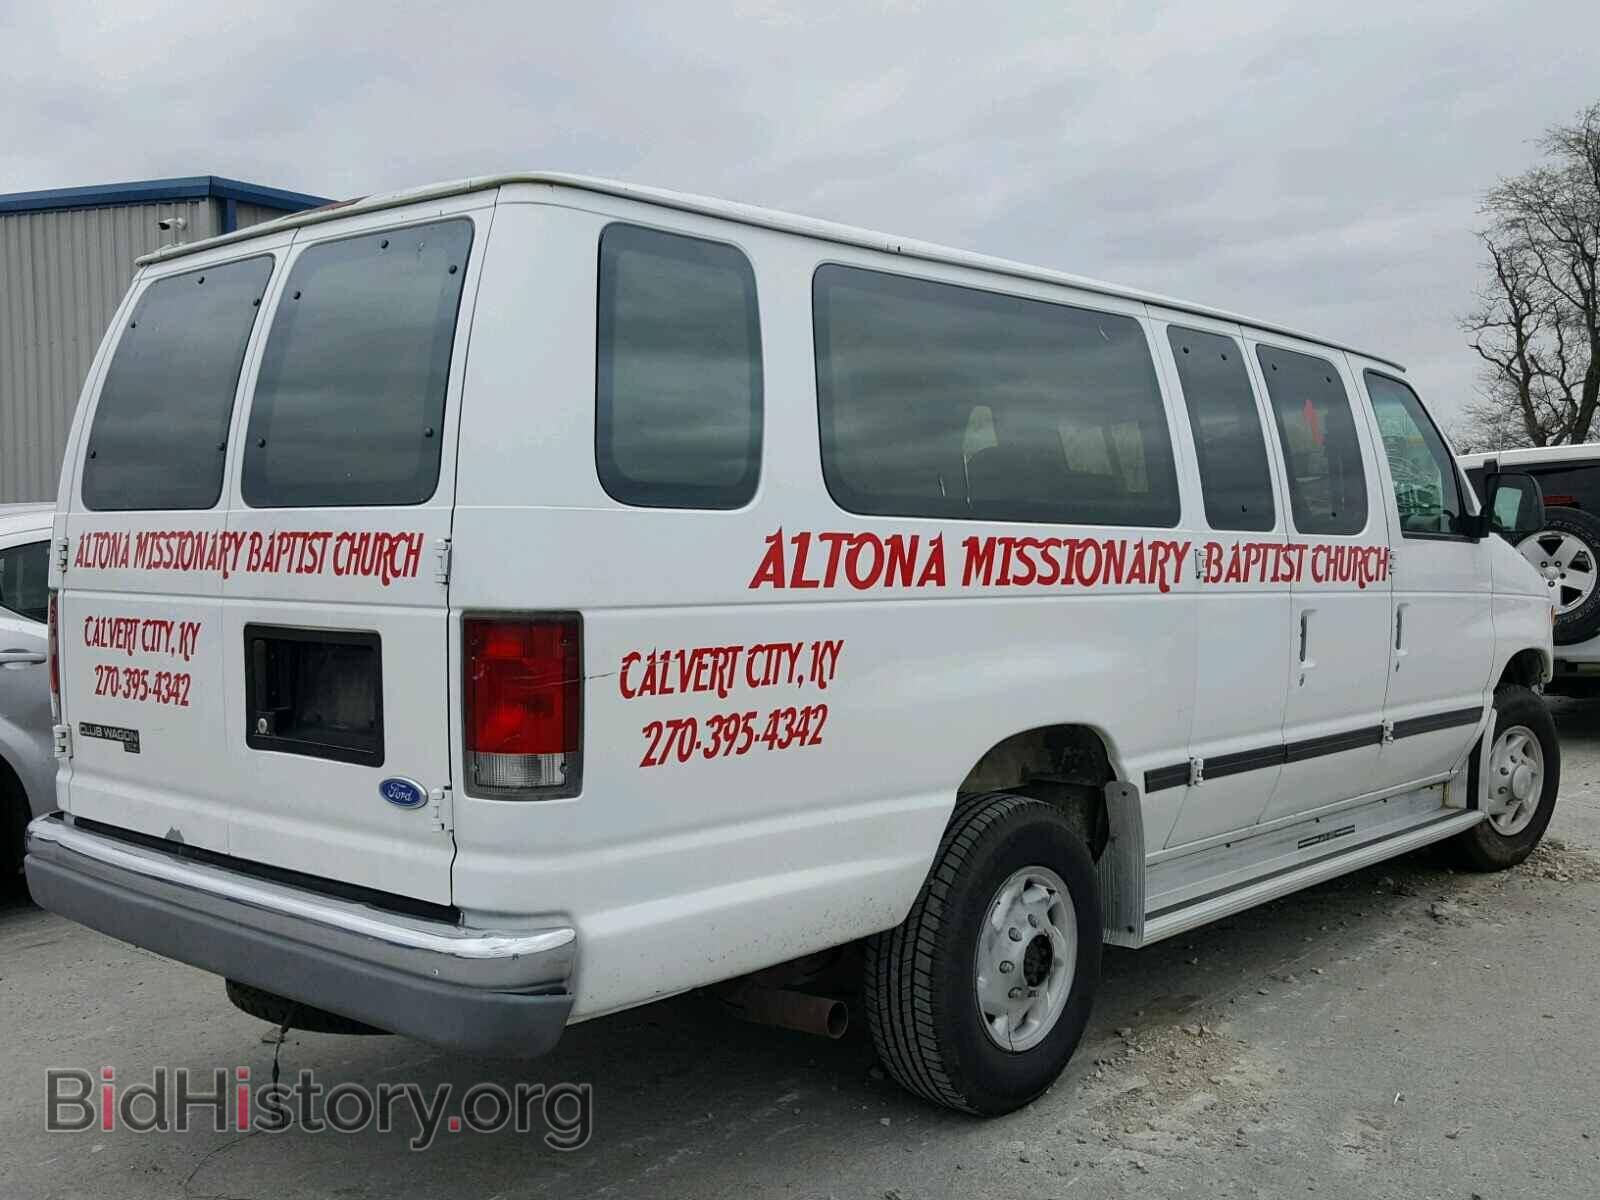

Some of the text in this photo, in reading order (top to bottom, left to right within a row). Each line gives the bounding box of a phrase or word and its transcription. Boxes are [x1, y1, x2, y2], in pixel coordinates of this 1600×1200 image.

[74, 528, 424, 586] ALTONA MISSIONARY BAPTIST CHURCH
[748, 526, 1389, 592] ALTONA MISSIONARY BAPTIST CHURCH
[84, 616, 140, 656] CALVERT
[142, 619, 174, 657] CITY,
[619, 639, 845, 699] CALVERT CITY, KY
[80, 723, 139, 743] CLUB WAGON
[387, 782, 413, 801] Ford
